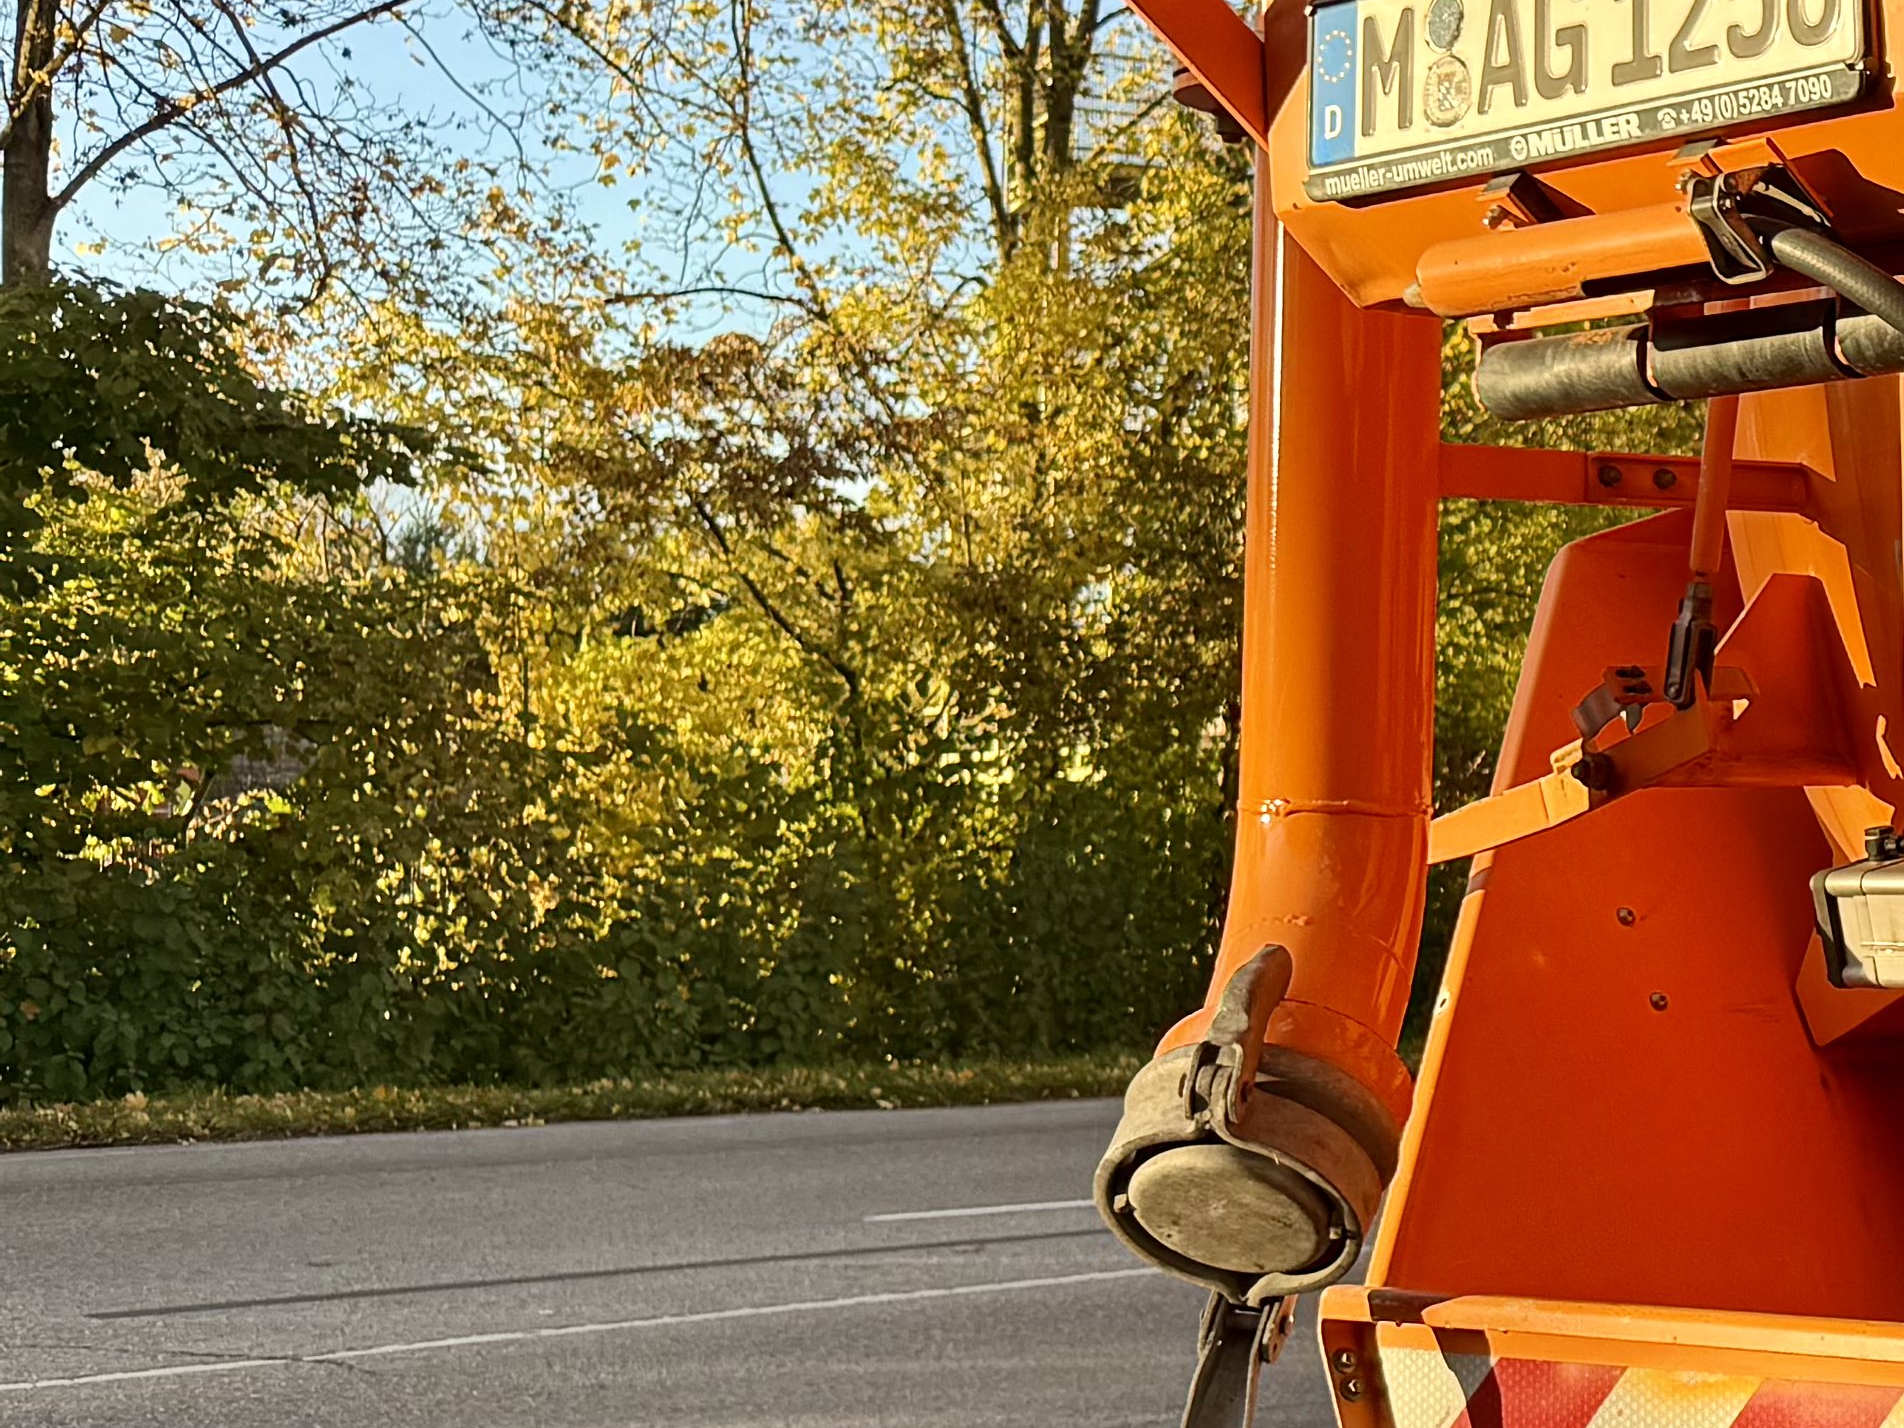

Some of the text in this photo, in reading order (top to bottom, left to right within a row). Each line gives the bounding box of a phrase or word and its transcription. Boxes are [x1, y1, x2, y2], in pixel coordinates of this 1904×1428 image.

[1323, 103, 1342, 141] D
[1361, 8, 1414, 138] M
[1325, 147, 1494, 197] mueller-umwelt.com
[1527, 112, 1641, 159] MÜLLER
[1785, 74, 1832, 105] 7090
